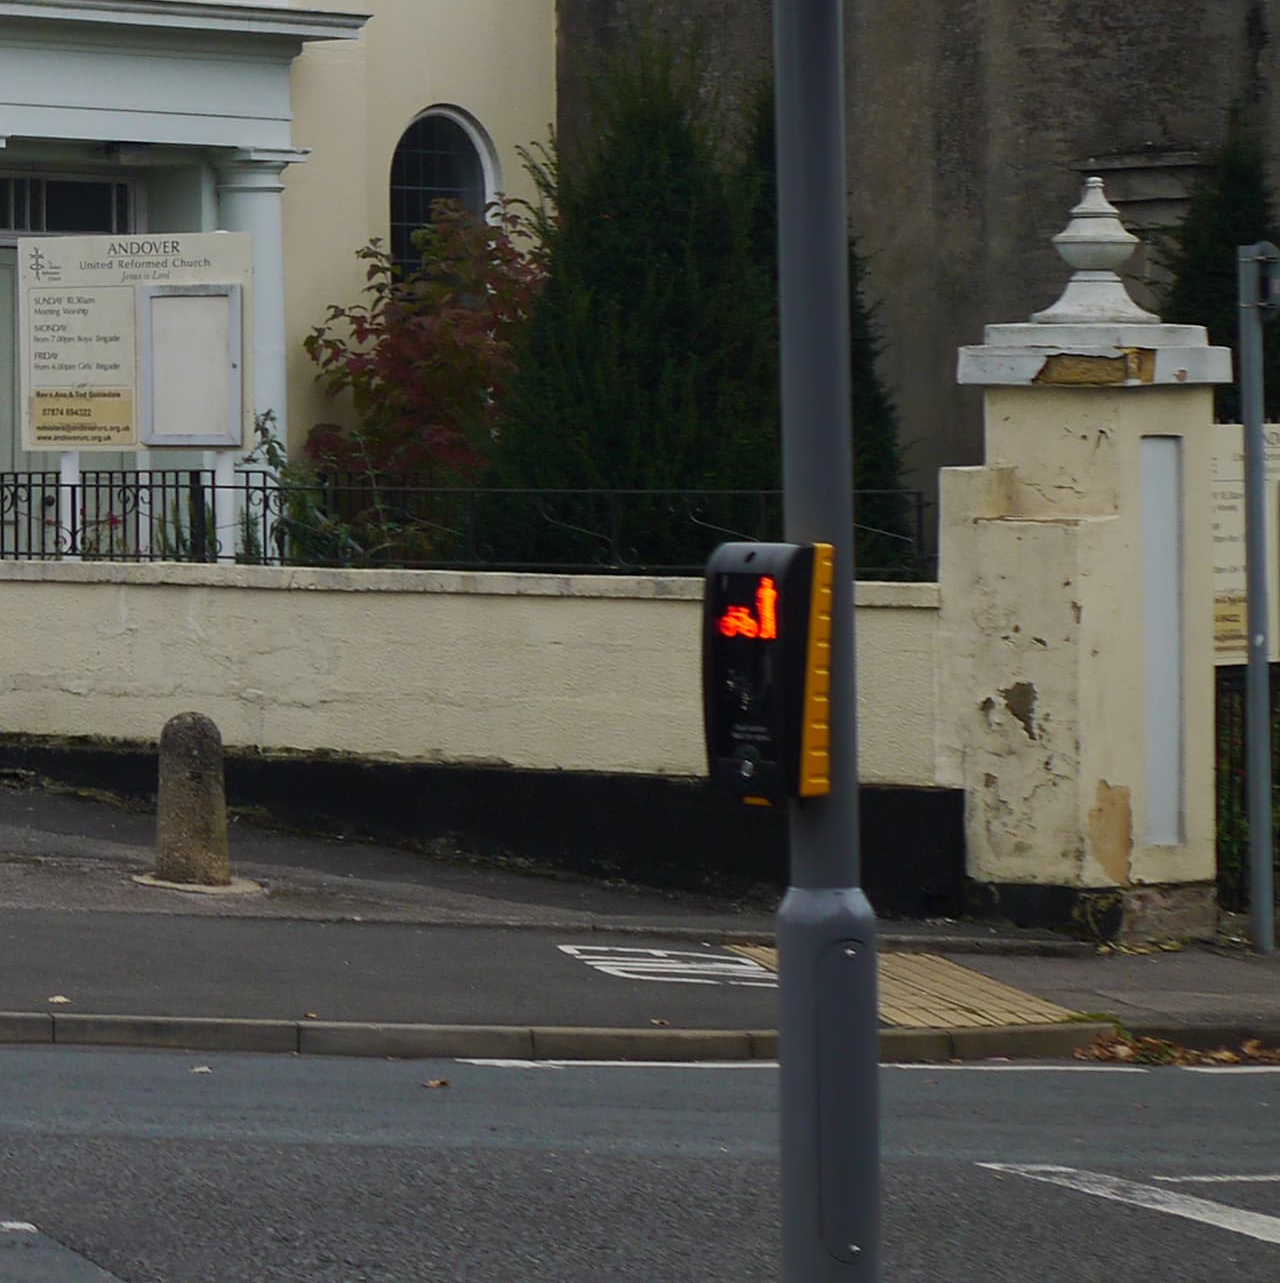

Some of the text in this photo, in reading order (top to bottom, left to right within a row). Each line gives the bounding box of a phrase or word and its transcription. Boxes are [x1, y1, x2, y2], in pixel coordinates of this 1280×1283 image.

[107, 240, 181, 255] ANDOVER
[79, 257, 211, 270] United Reformed Church
[152, 270, 170, 280] Lord
